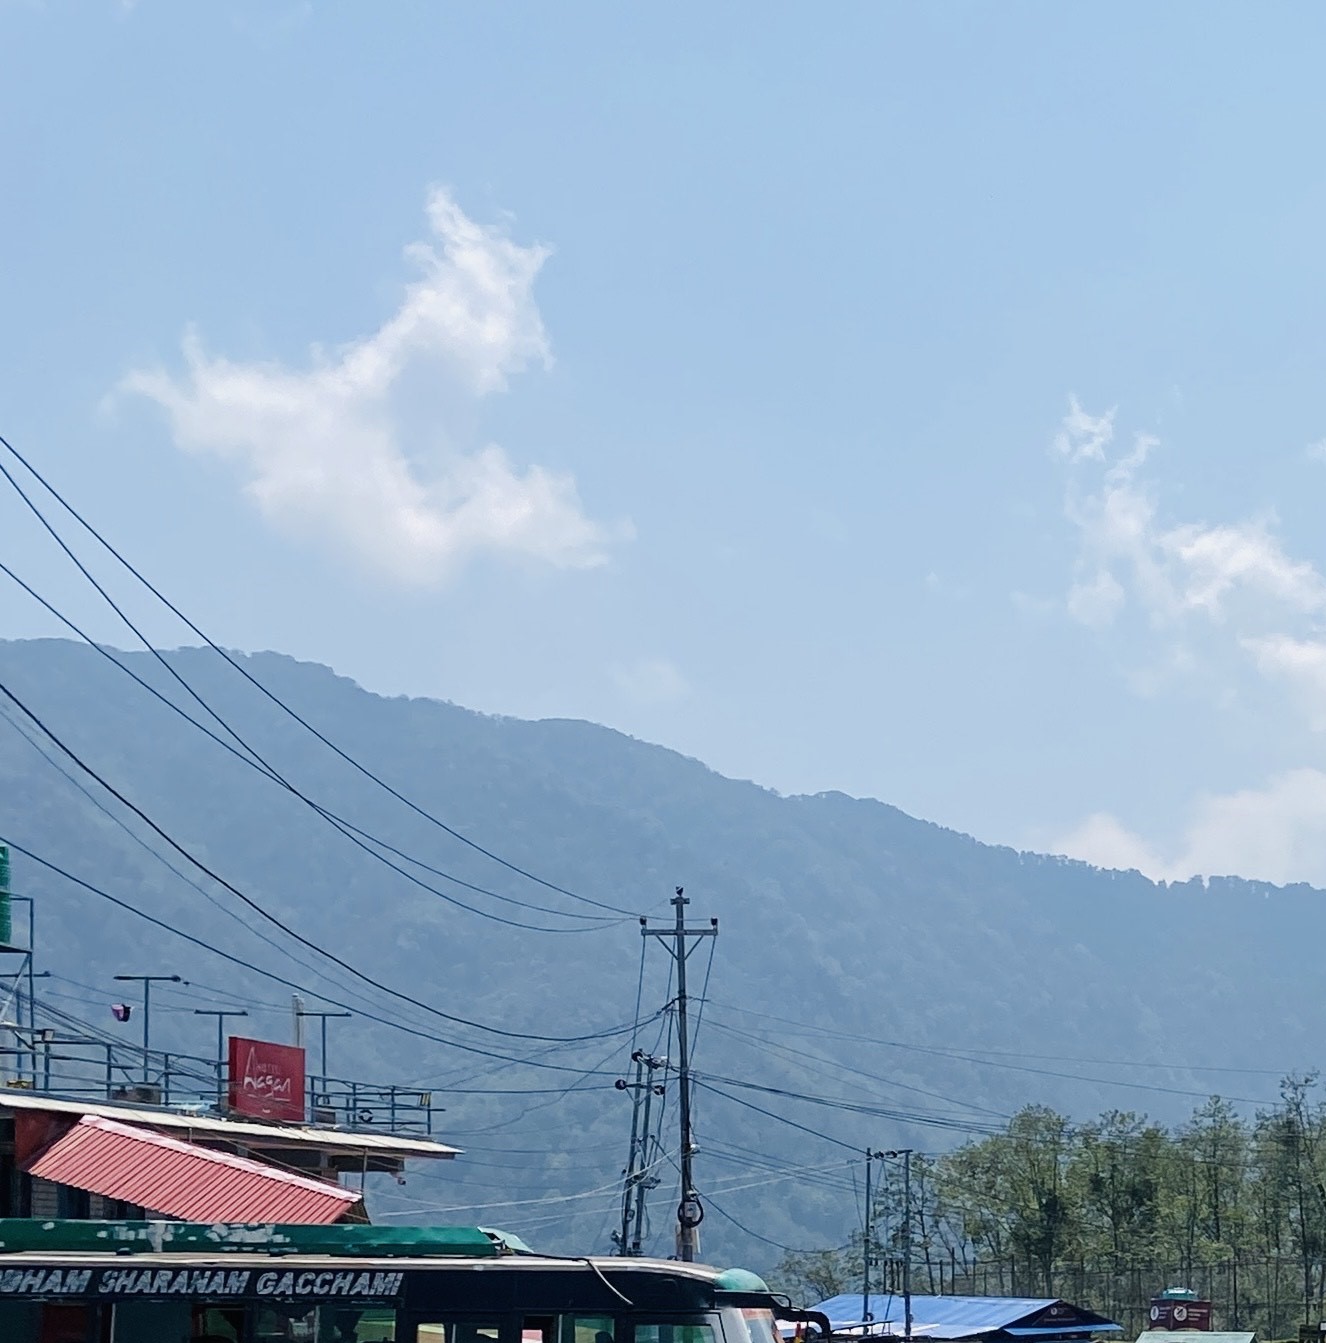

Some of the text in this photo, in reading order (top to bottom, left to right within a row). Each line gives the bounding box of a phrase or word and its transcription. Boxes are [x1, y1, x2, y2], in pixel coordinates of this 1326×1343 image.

[0, 1269, 404, 1296] DHAM SHARANAM GACCHAMI
